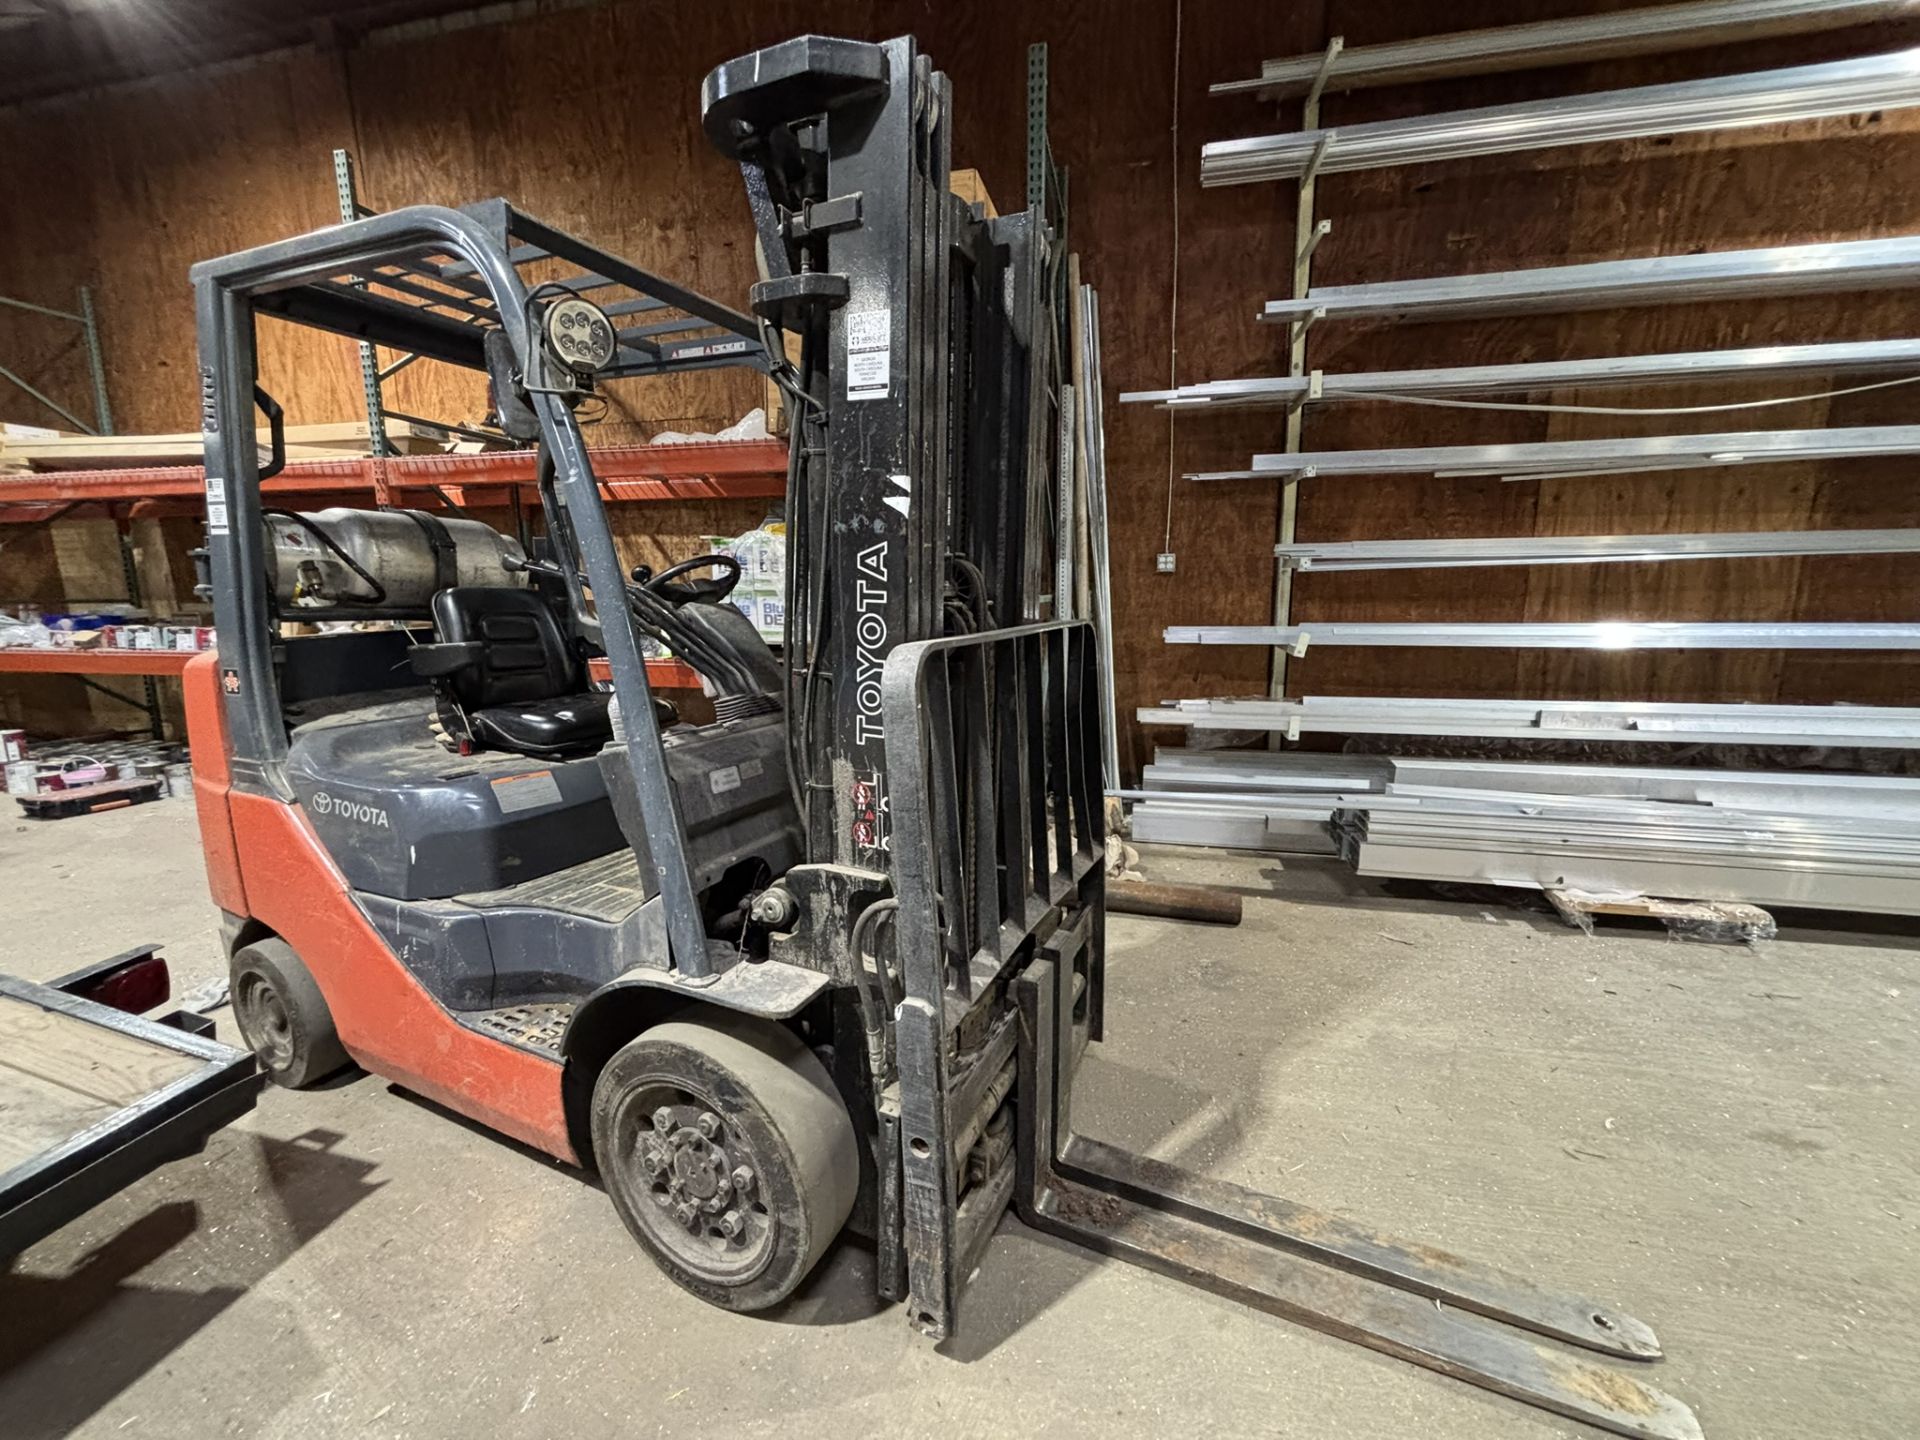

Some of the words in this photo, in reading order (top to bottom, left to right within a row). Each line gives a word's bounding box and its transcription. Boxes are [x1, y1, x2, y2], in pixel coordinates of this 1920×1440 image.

[764, 602, 785, 614] Blu
[765, 614, 785, 626] DE
[856, 541, 888, 746] TOYOTA
[333, 798, 389, 828] TOYOTA
